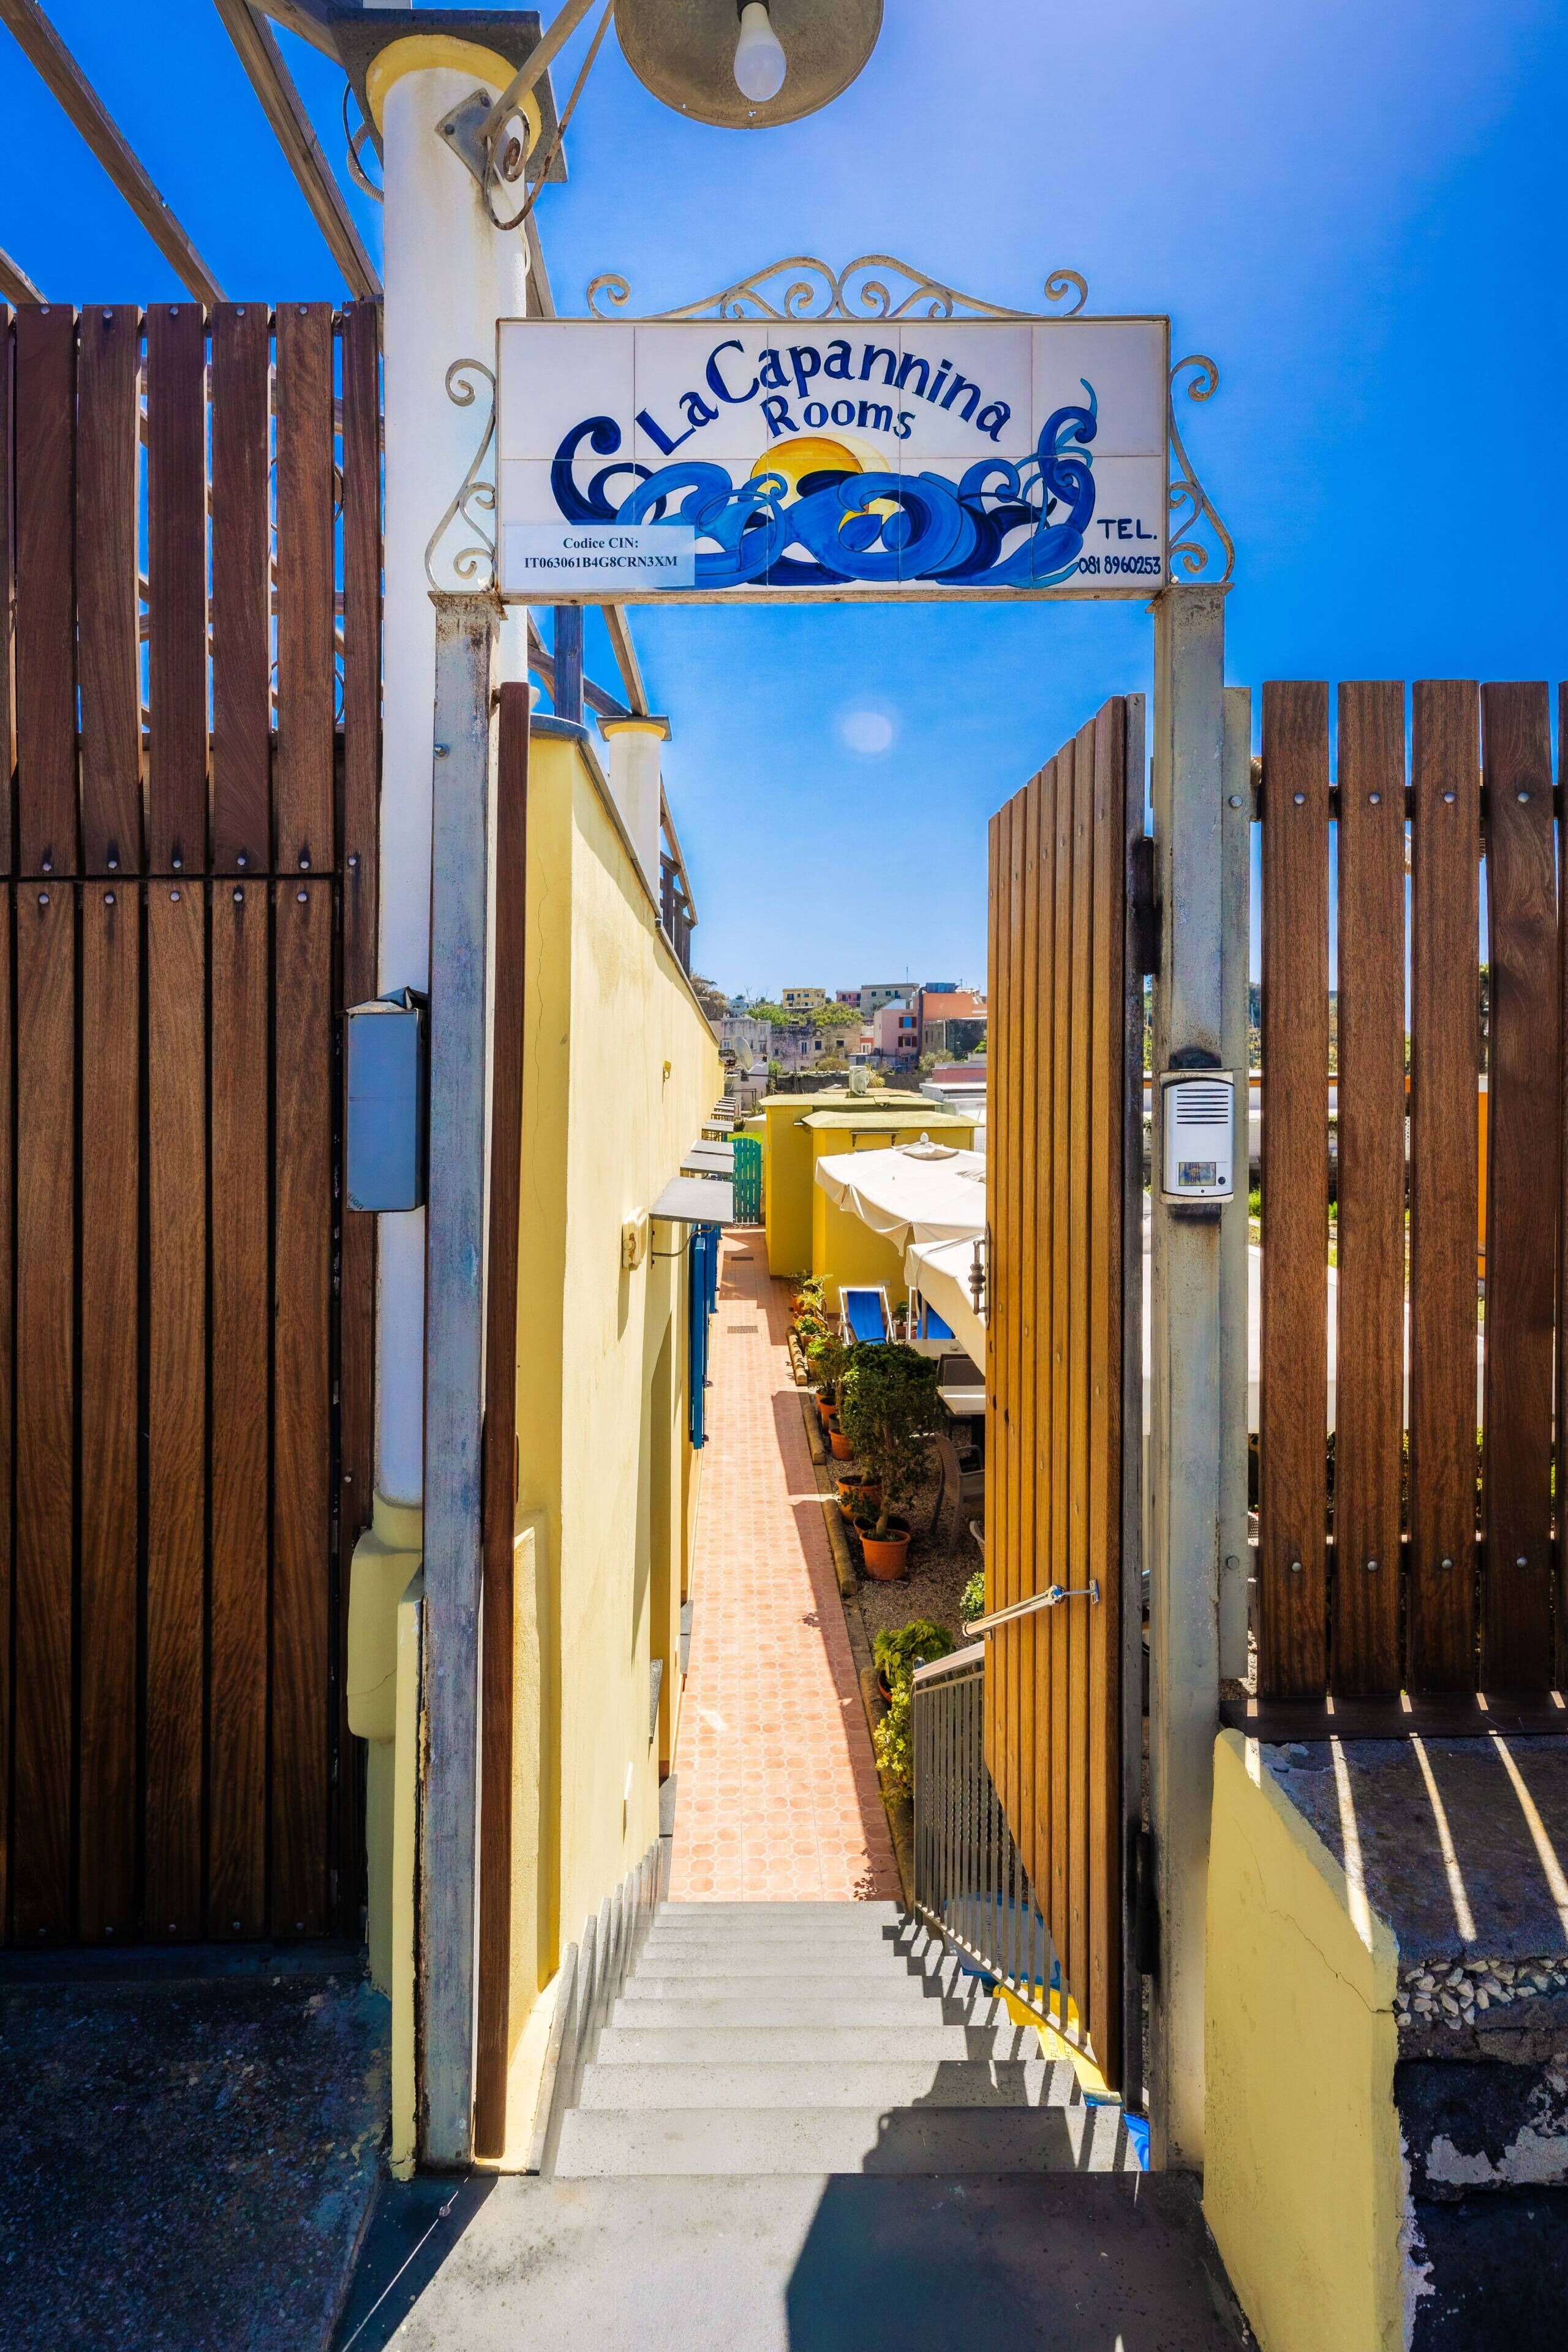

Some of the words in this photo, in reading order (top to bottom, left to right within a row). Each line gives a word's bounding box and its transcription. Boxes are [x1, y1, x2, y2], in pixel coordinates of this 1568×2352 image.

[635, 391, 718, 455] La
[706, 339, 1011, 442] Capannina
[760, 396, 916, 439] Rooms
[1097, 519, 1157, 539] TEL.
[564, 538, 605, 548] Codice
[609, 537, 638, 548] CIN:
[524, 556, 677, 568] IT063061B4G8CRN3XM
[1104, 556, 1161, 575] 8960253
